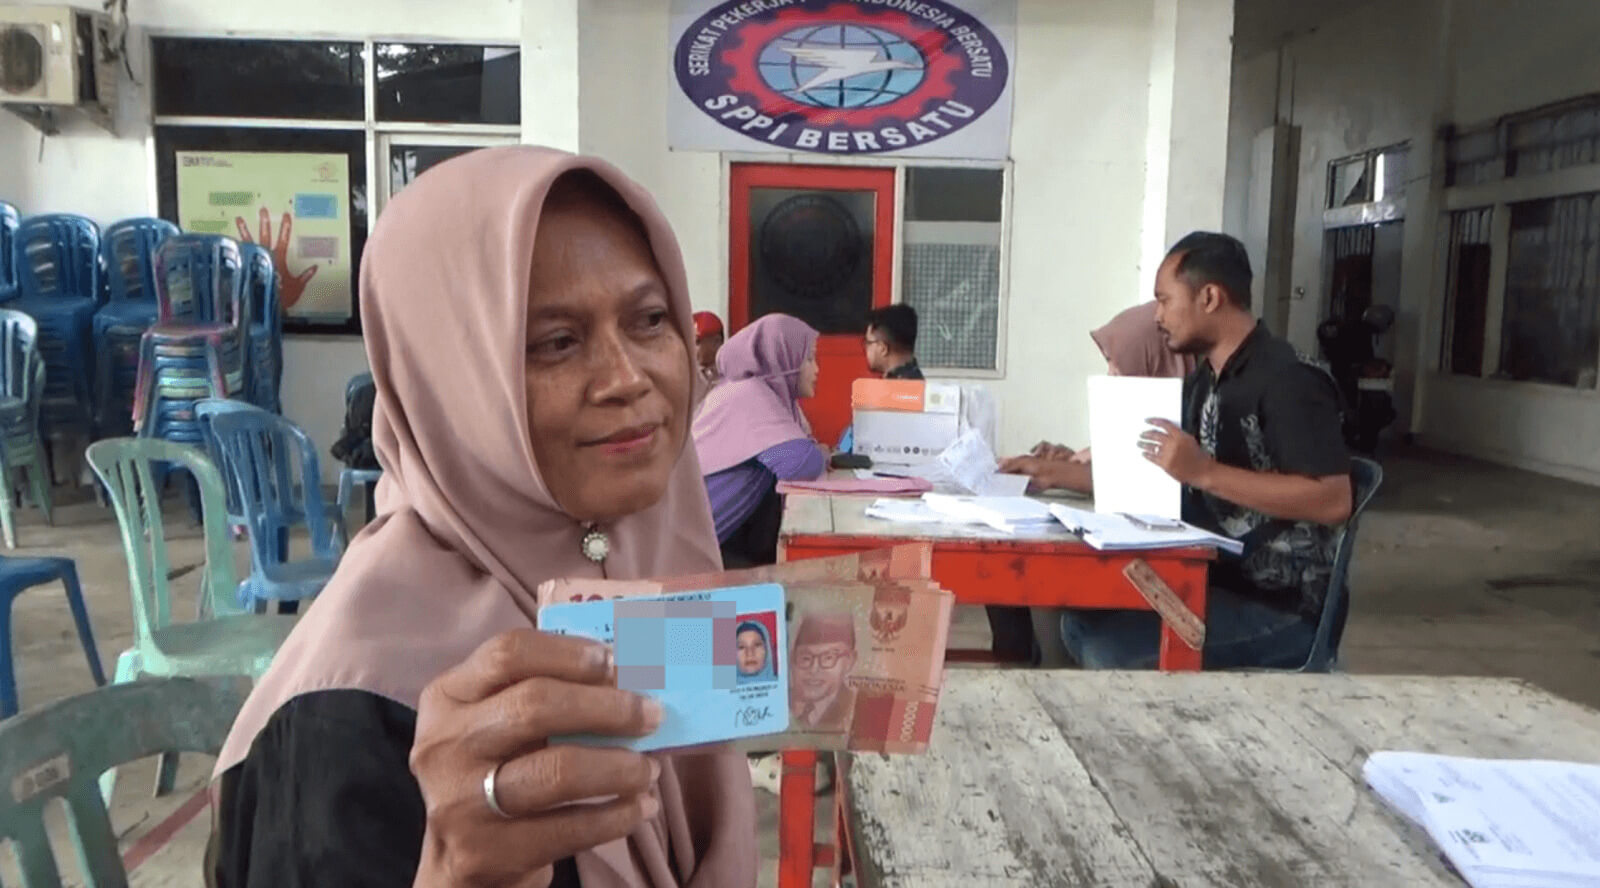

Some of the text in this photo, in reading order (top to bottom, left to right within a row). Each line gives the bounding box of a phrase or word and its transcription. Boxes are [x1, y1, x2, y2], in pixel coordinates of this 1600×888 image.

[688, 27, 721, 76] SERIKAT
[850, 0, 954, 29] ONESIA
[950, 25, 993, 78] BERSATU
[705, 94, 975, 150] SPPI BERSATU
